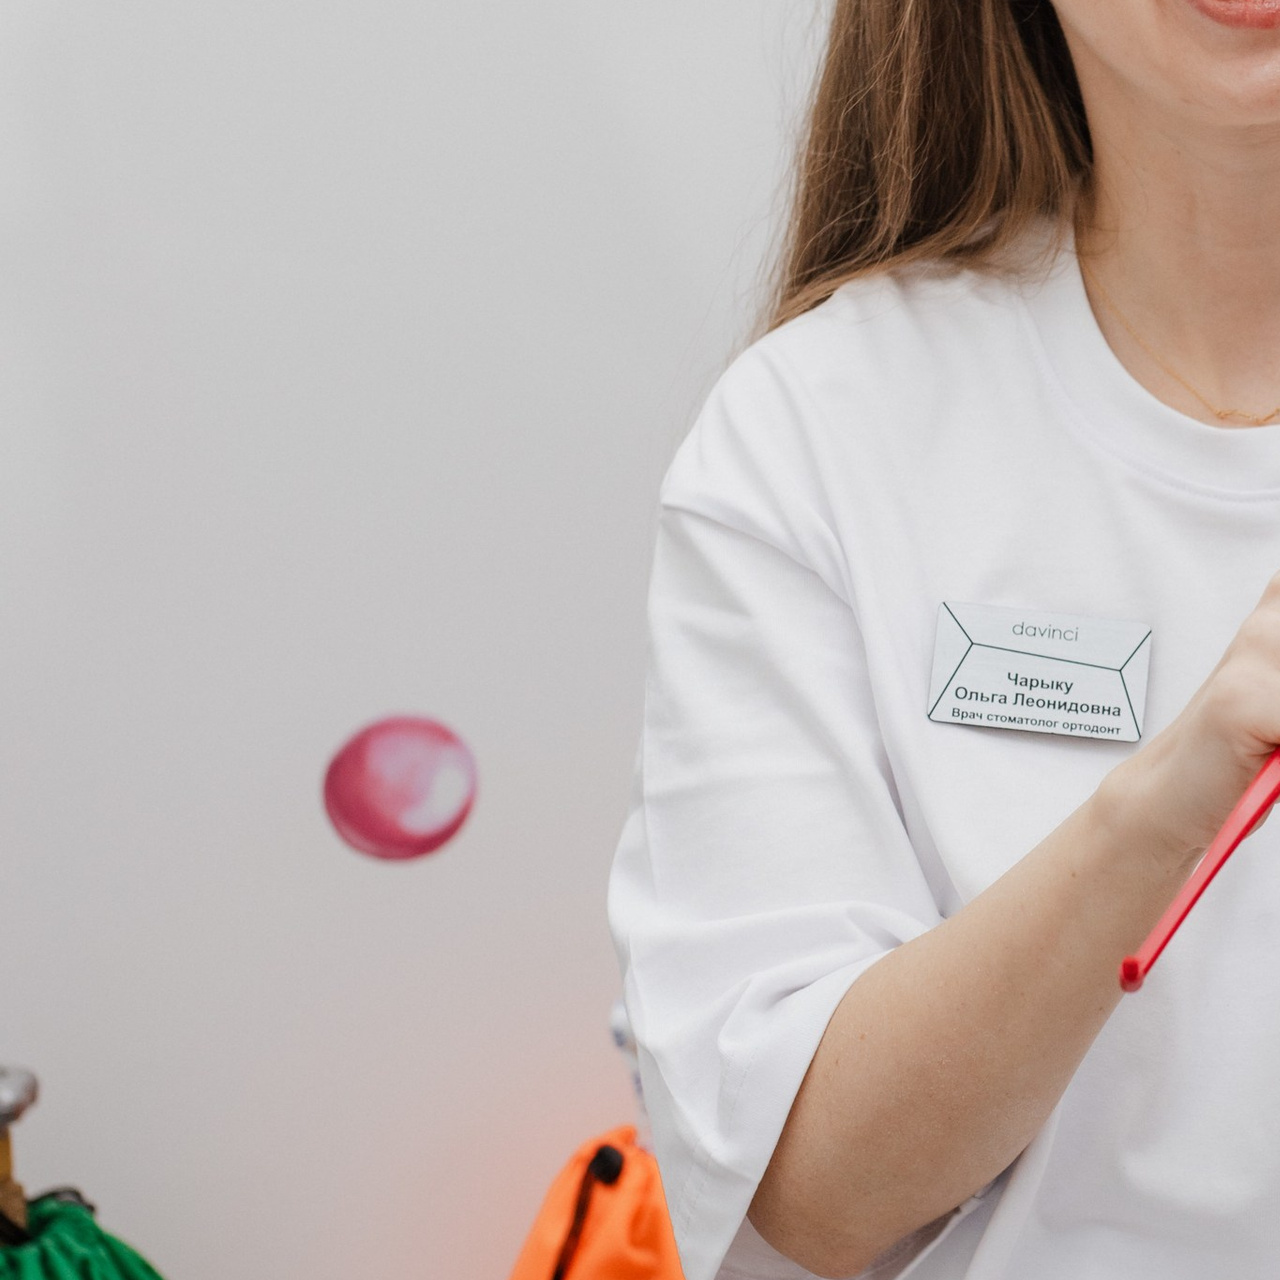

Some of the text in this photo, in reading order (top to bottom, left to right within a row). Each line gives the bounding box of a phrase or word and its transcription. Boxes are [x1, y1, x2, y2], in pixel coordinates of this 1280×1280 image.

[1012, 621, 1079, 642] davinci
[1006, 672, 1074, 695] Чарыку
[954, 686, 1122, 717] Ольга Леонидовна
[951, 707, 1122, 735] Врач стоматолог ортодонт
